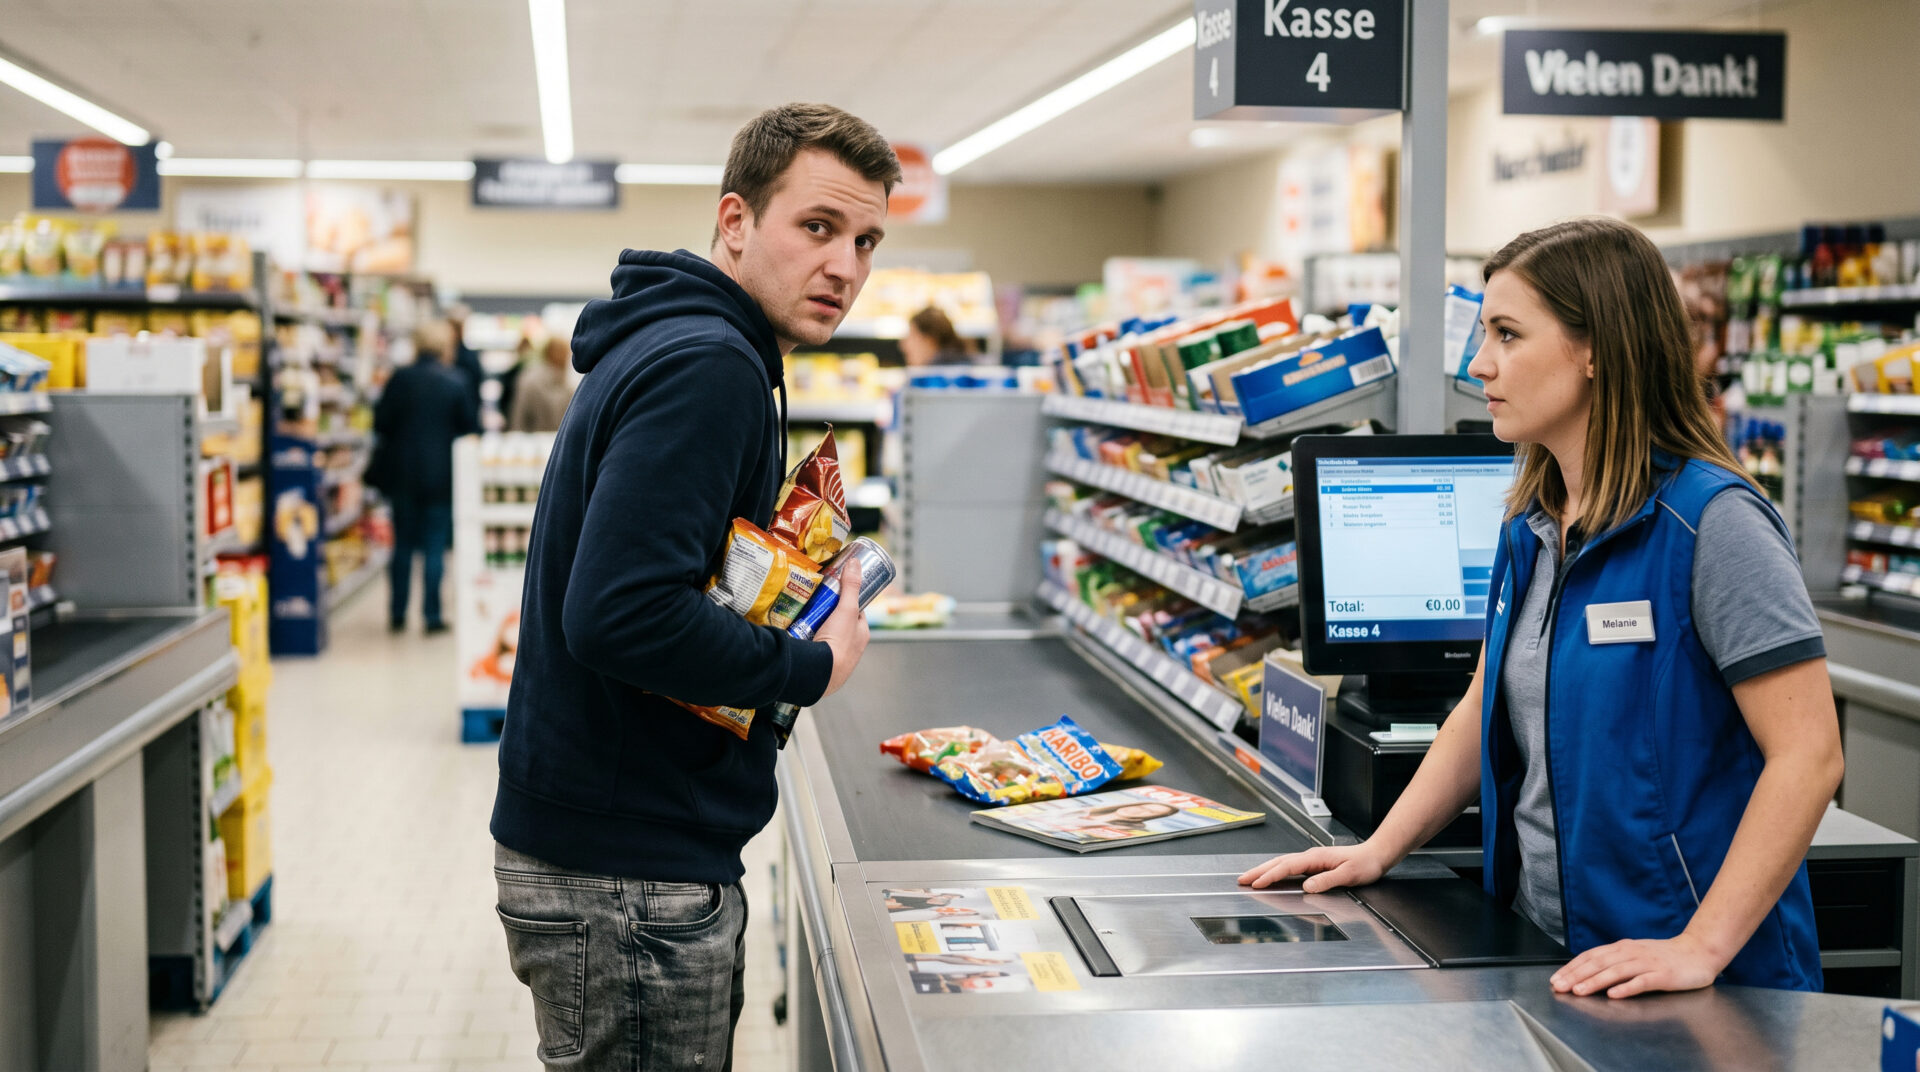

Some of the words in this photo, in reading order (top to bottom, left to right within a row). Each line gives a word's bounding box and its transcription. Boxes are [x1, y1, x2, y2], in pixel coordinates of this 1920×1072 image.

[1197, 8, 1232, 50] Kasse
[1264, 0, 1376, 40] Kasse
[1209, 57, 1219, 97] 4
[1305, 52, 1331, 92] 4
[1525, 49, 1644, 96] Vielen
[1652, 53, 1758, 98] Dank!
[1328, 600, 1365, 613] Total:
[1425, 599, 1461, 612] €0.00
[1602, 619, 1637, 628] Melanie
[1328, 624, 1369, 638] Kasse
[1371, 624, 1381, 637] 4
[1266, 690, 1290, 728] Vielen
[1291, 705, 1316, 742] Dank!
[1041, 729, 1103, 780] HARIBO
